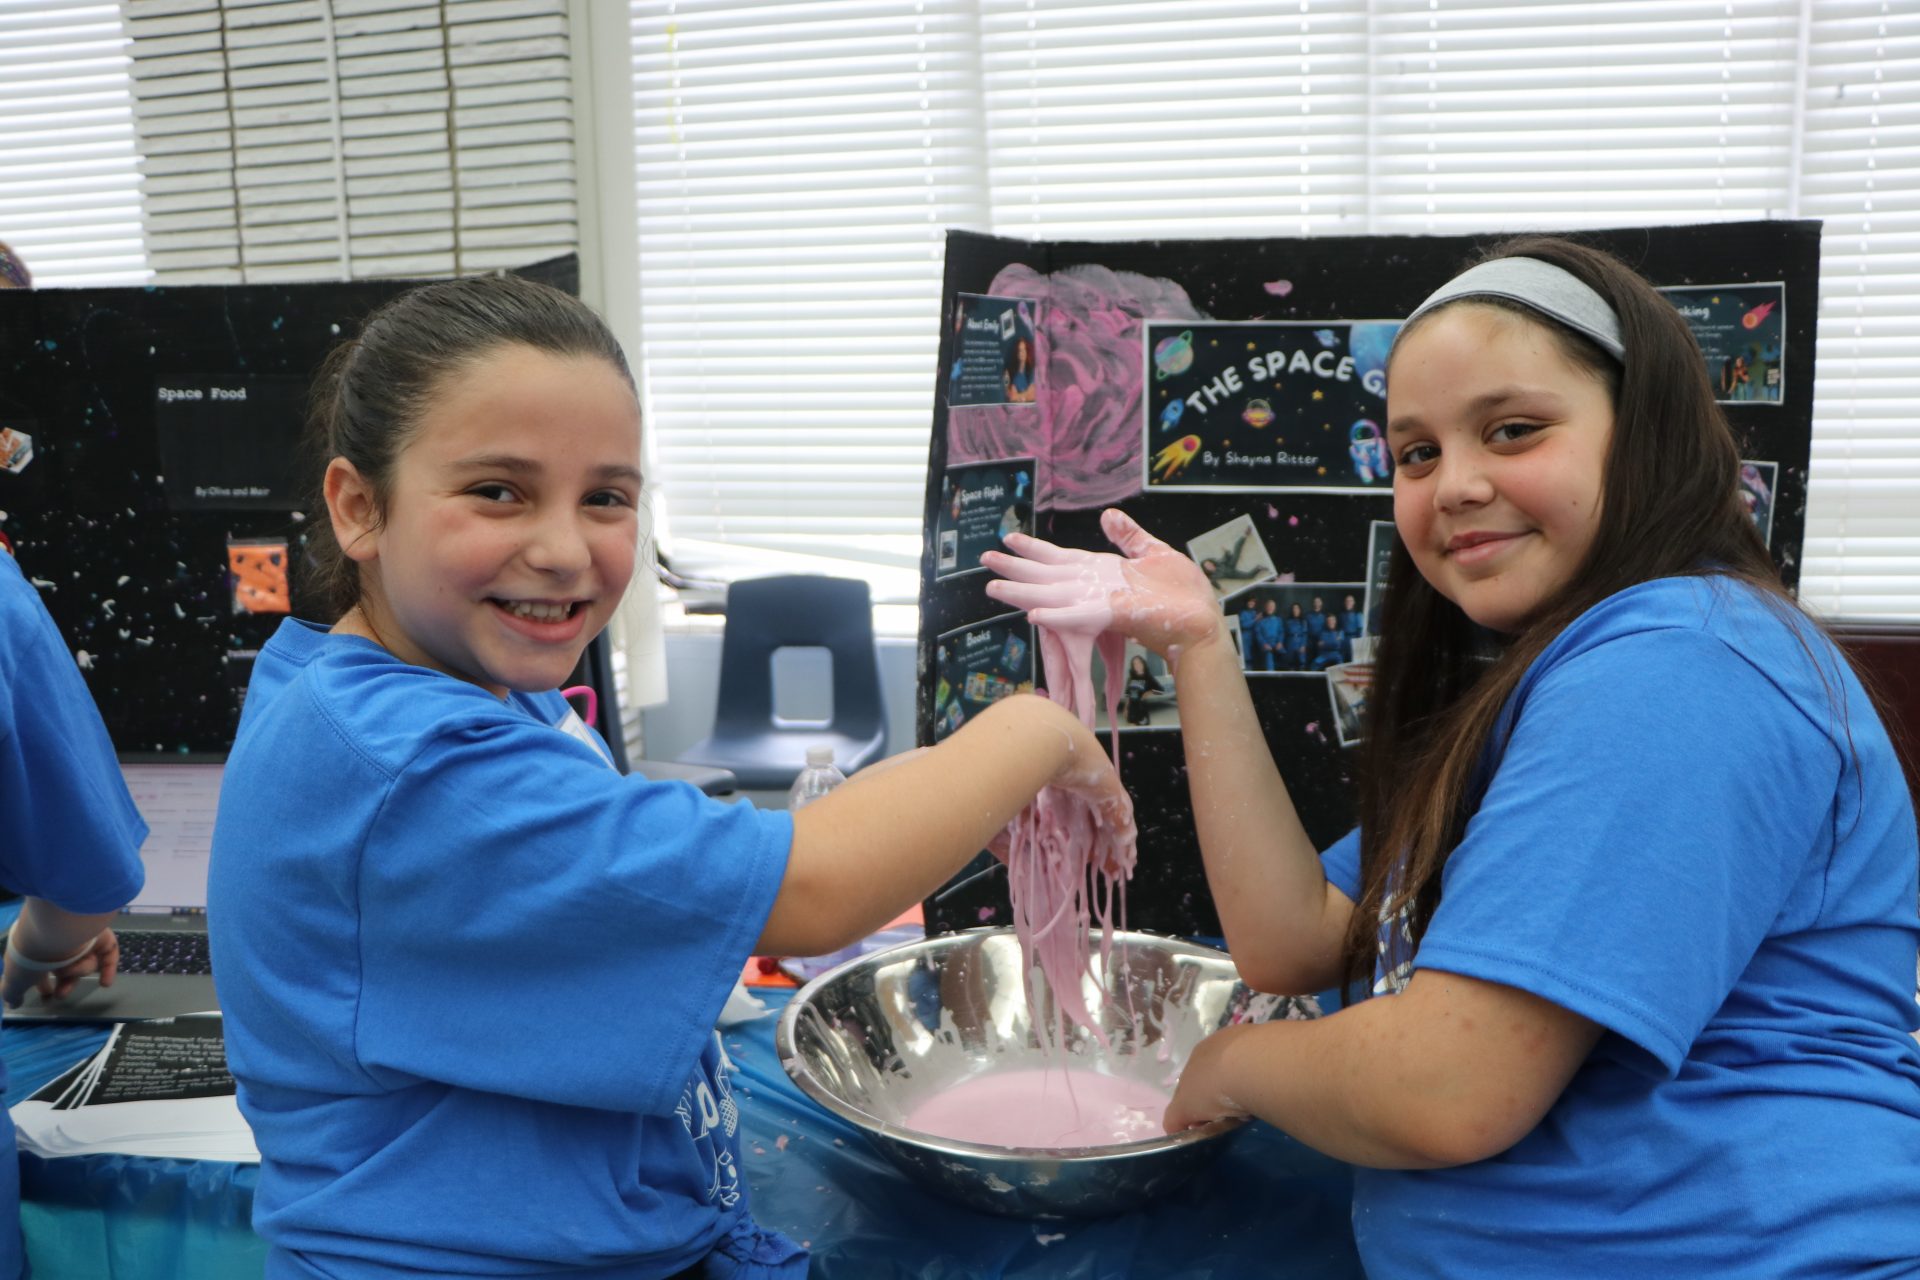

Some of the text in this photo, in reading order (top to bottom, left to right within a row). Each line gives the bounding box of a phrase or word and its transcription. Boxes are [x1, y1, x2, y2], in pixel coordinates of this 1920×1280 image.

[984, 318, 999, 334] Emily
[1186, 366, 1244, 414] THE
[1248, 349, 1356, 382] SPACE
[158, 387, 247, 403] Space Food
[1203, 451, 1319, 466] By Shayna Ritter
[195, 486, 206, 498] By
[232, 486, 248, 497] and
[961, 489, 982, 505] Space
[966, 629, 992, 647] Books
